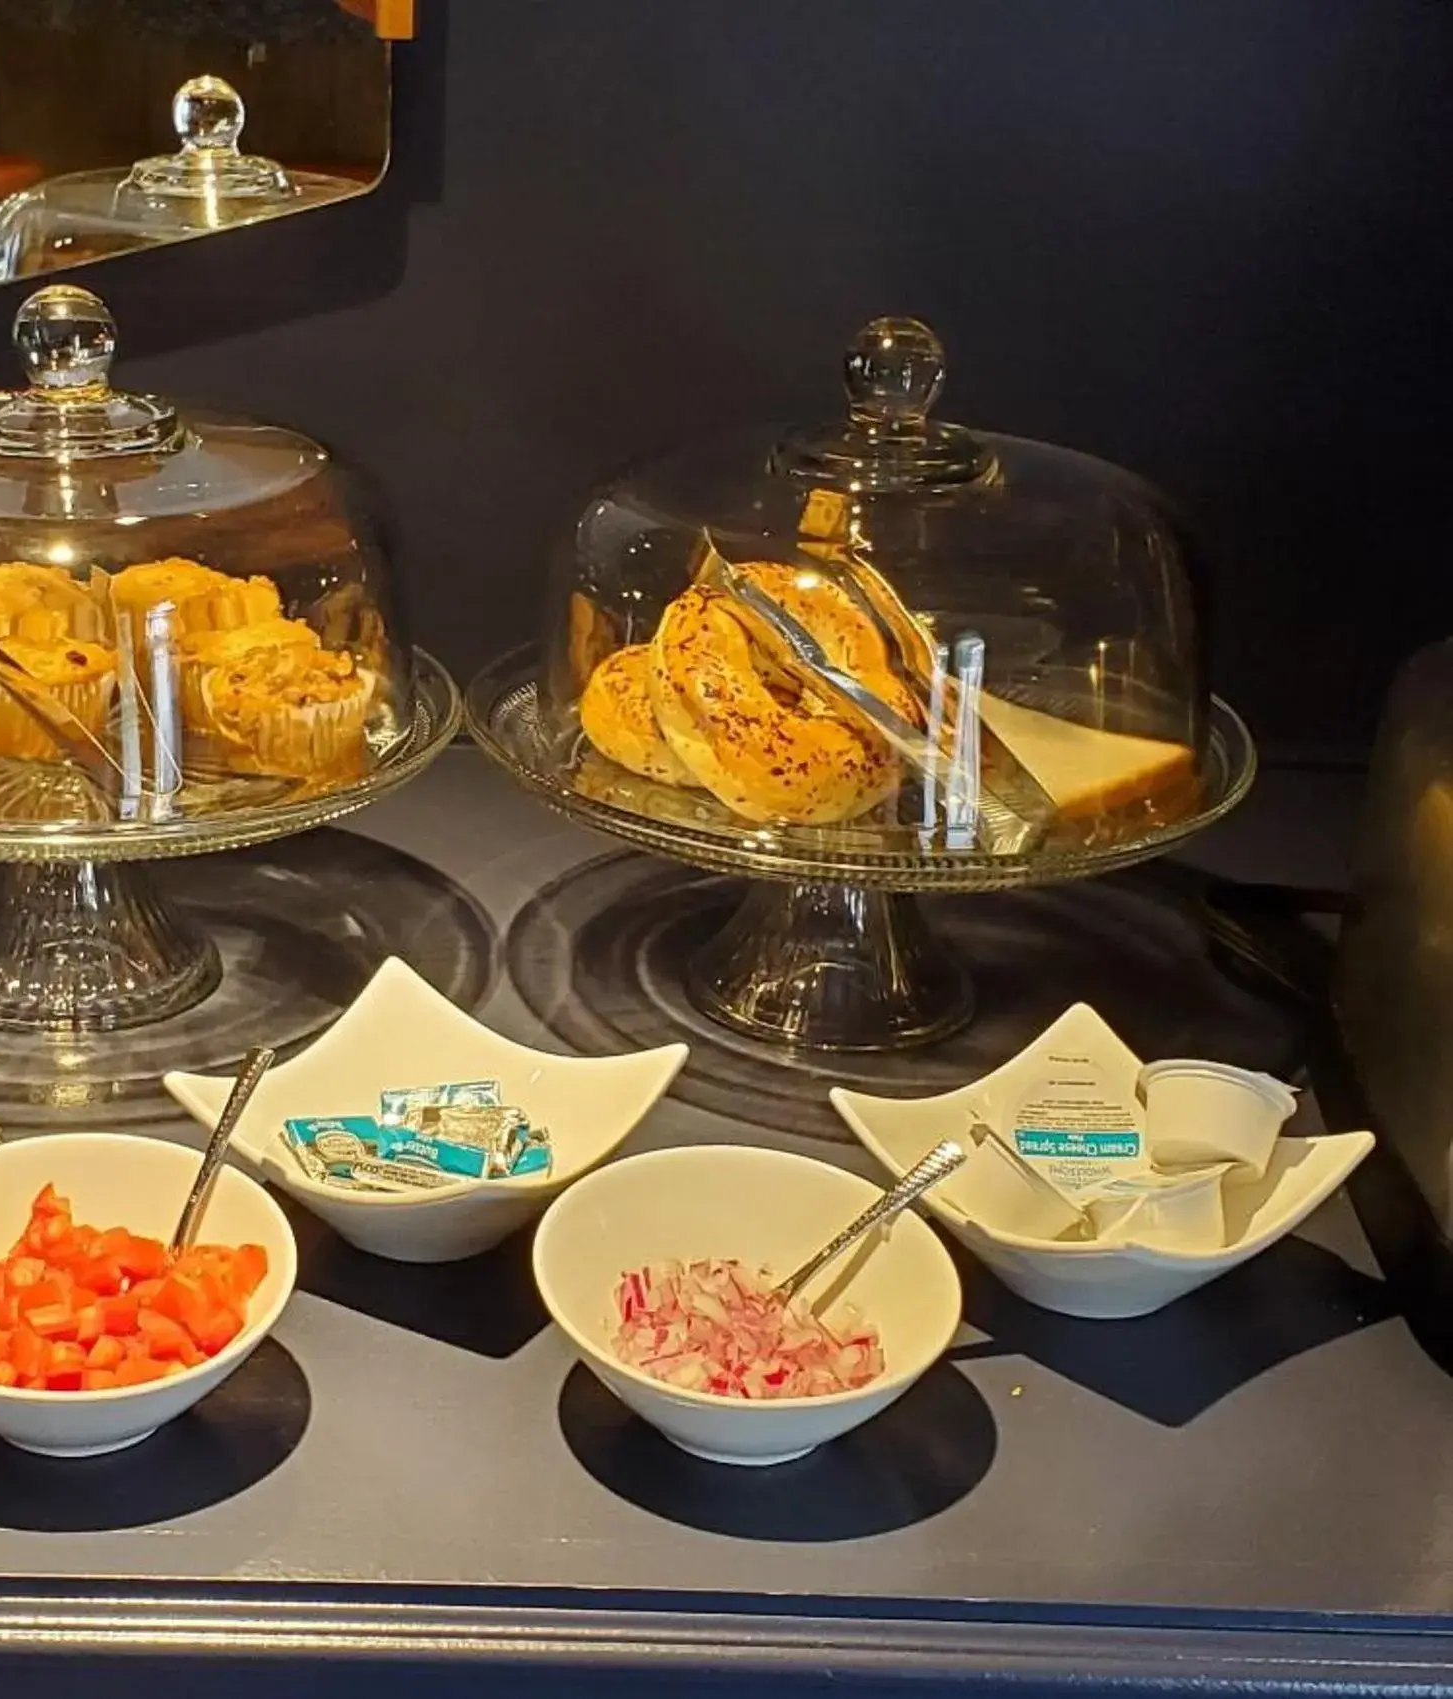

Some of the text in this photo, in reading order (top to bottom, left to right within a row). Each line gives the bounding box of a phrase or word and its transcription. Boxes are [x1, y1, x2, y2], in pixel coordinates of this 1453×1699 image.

[1018, 1138, 1137, 1156] Cream Cheese Spread
